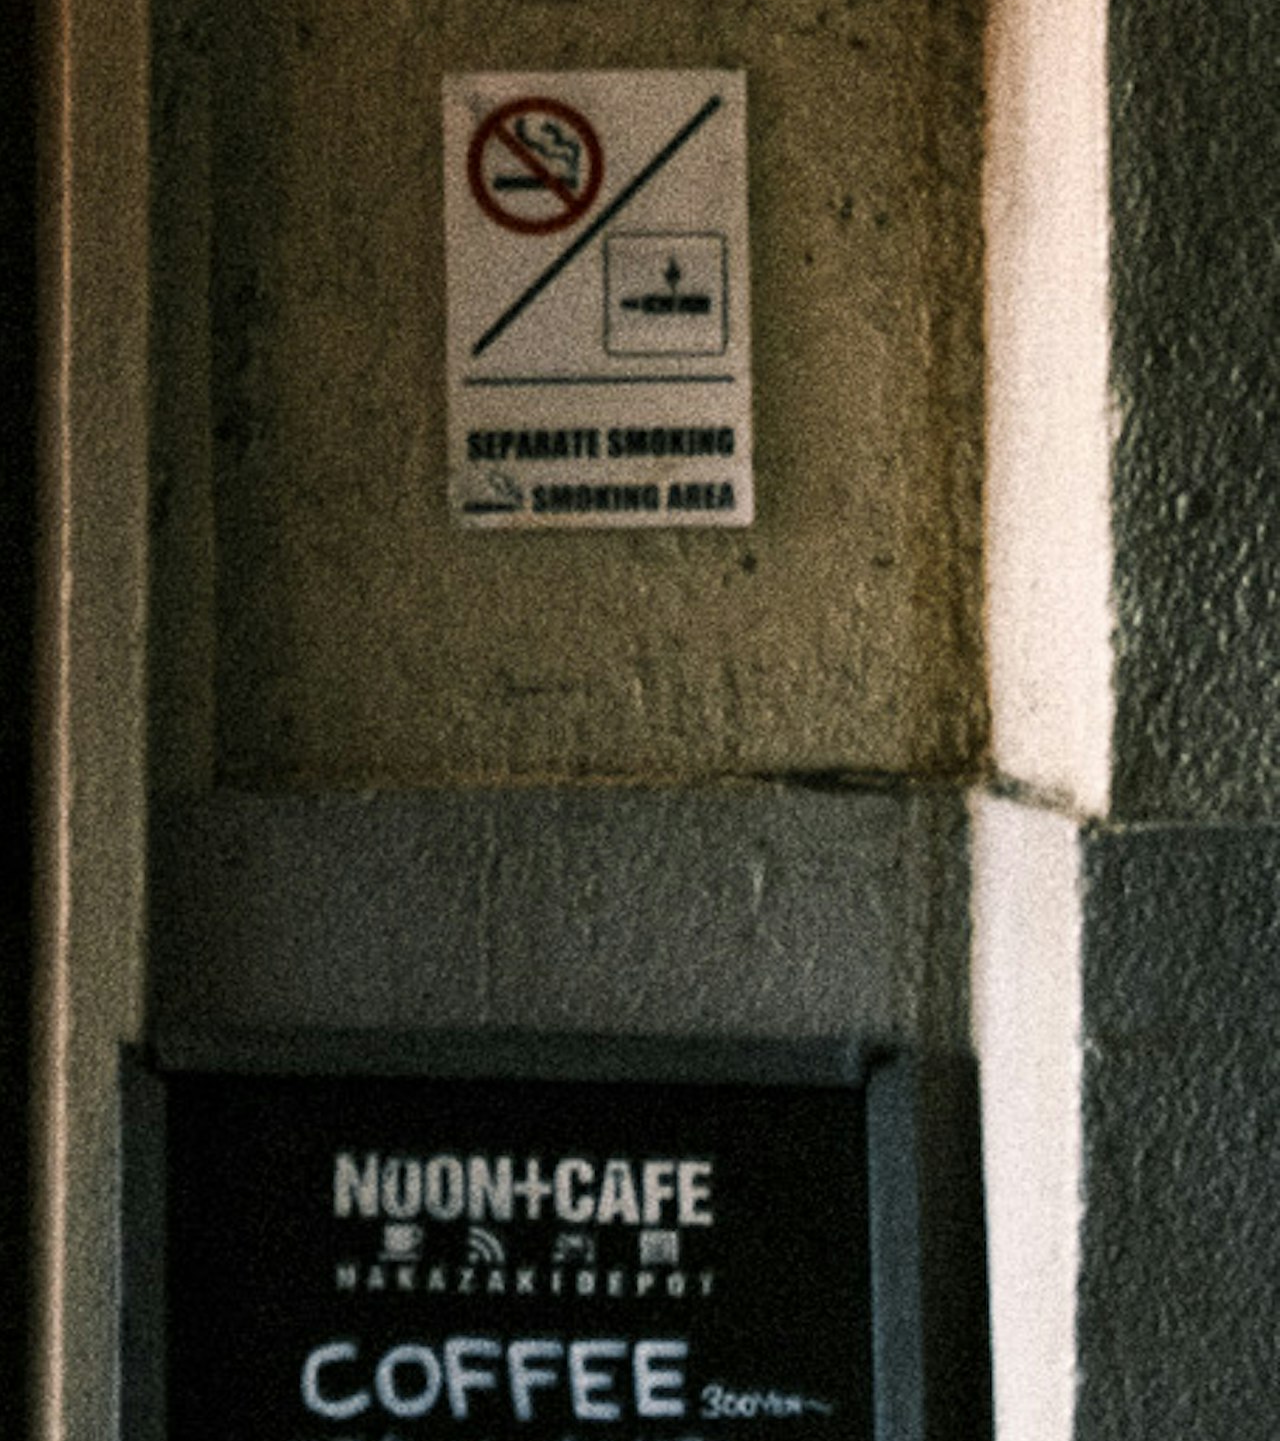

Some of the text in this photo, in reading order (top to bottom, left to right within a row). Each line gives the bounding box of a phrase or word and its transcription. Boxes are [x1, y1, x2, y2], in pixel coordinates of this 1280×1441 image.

[466, 426, 735, 461] SEPARATE SMOKING
[532, 482, 735, 512] SMOKING AREA
[300, 1336, 691, 1424] COFFEE
